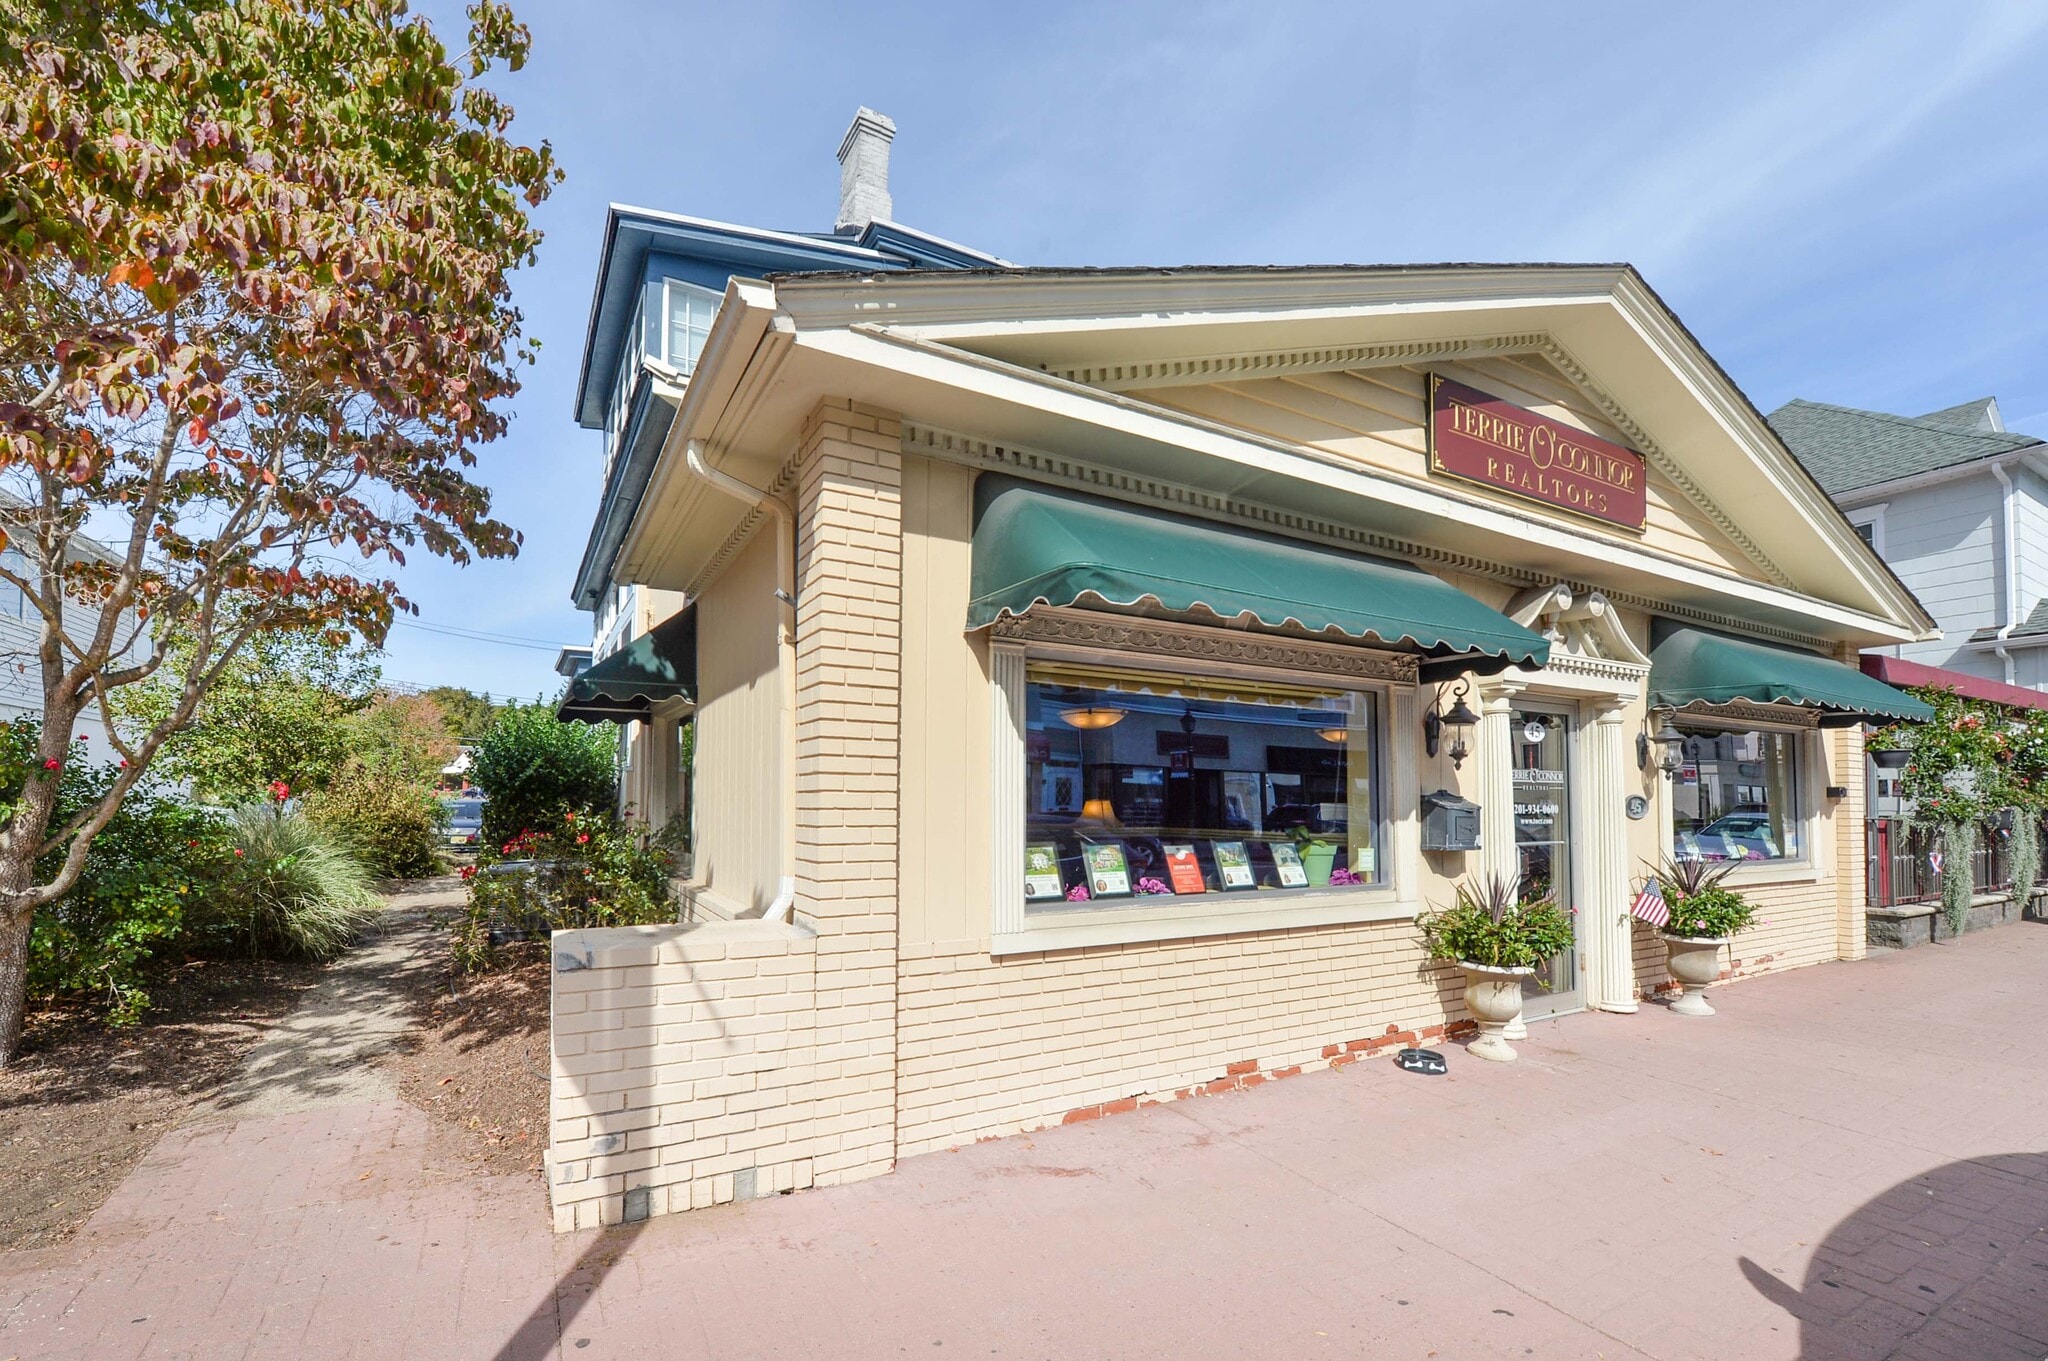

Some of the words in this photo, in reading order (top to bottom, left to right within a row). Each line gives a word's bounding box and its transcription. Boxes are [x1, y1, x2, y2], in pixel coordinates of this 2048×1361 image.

[1449, 402, 1526, 453] TERRIE
[1529, 424, 1635, 489] O'CONNOR
[1487, 456, 1608, 513] REALTORS
[1528, 725, 1541, 738] 45
[1512, 770, 1529, 780] ERRIE
[1529, 768, 1564, 783] O'CONNOR
[1514, 804, 1559, 814] 201-934-0600
